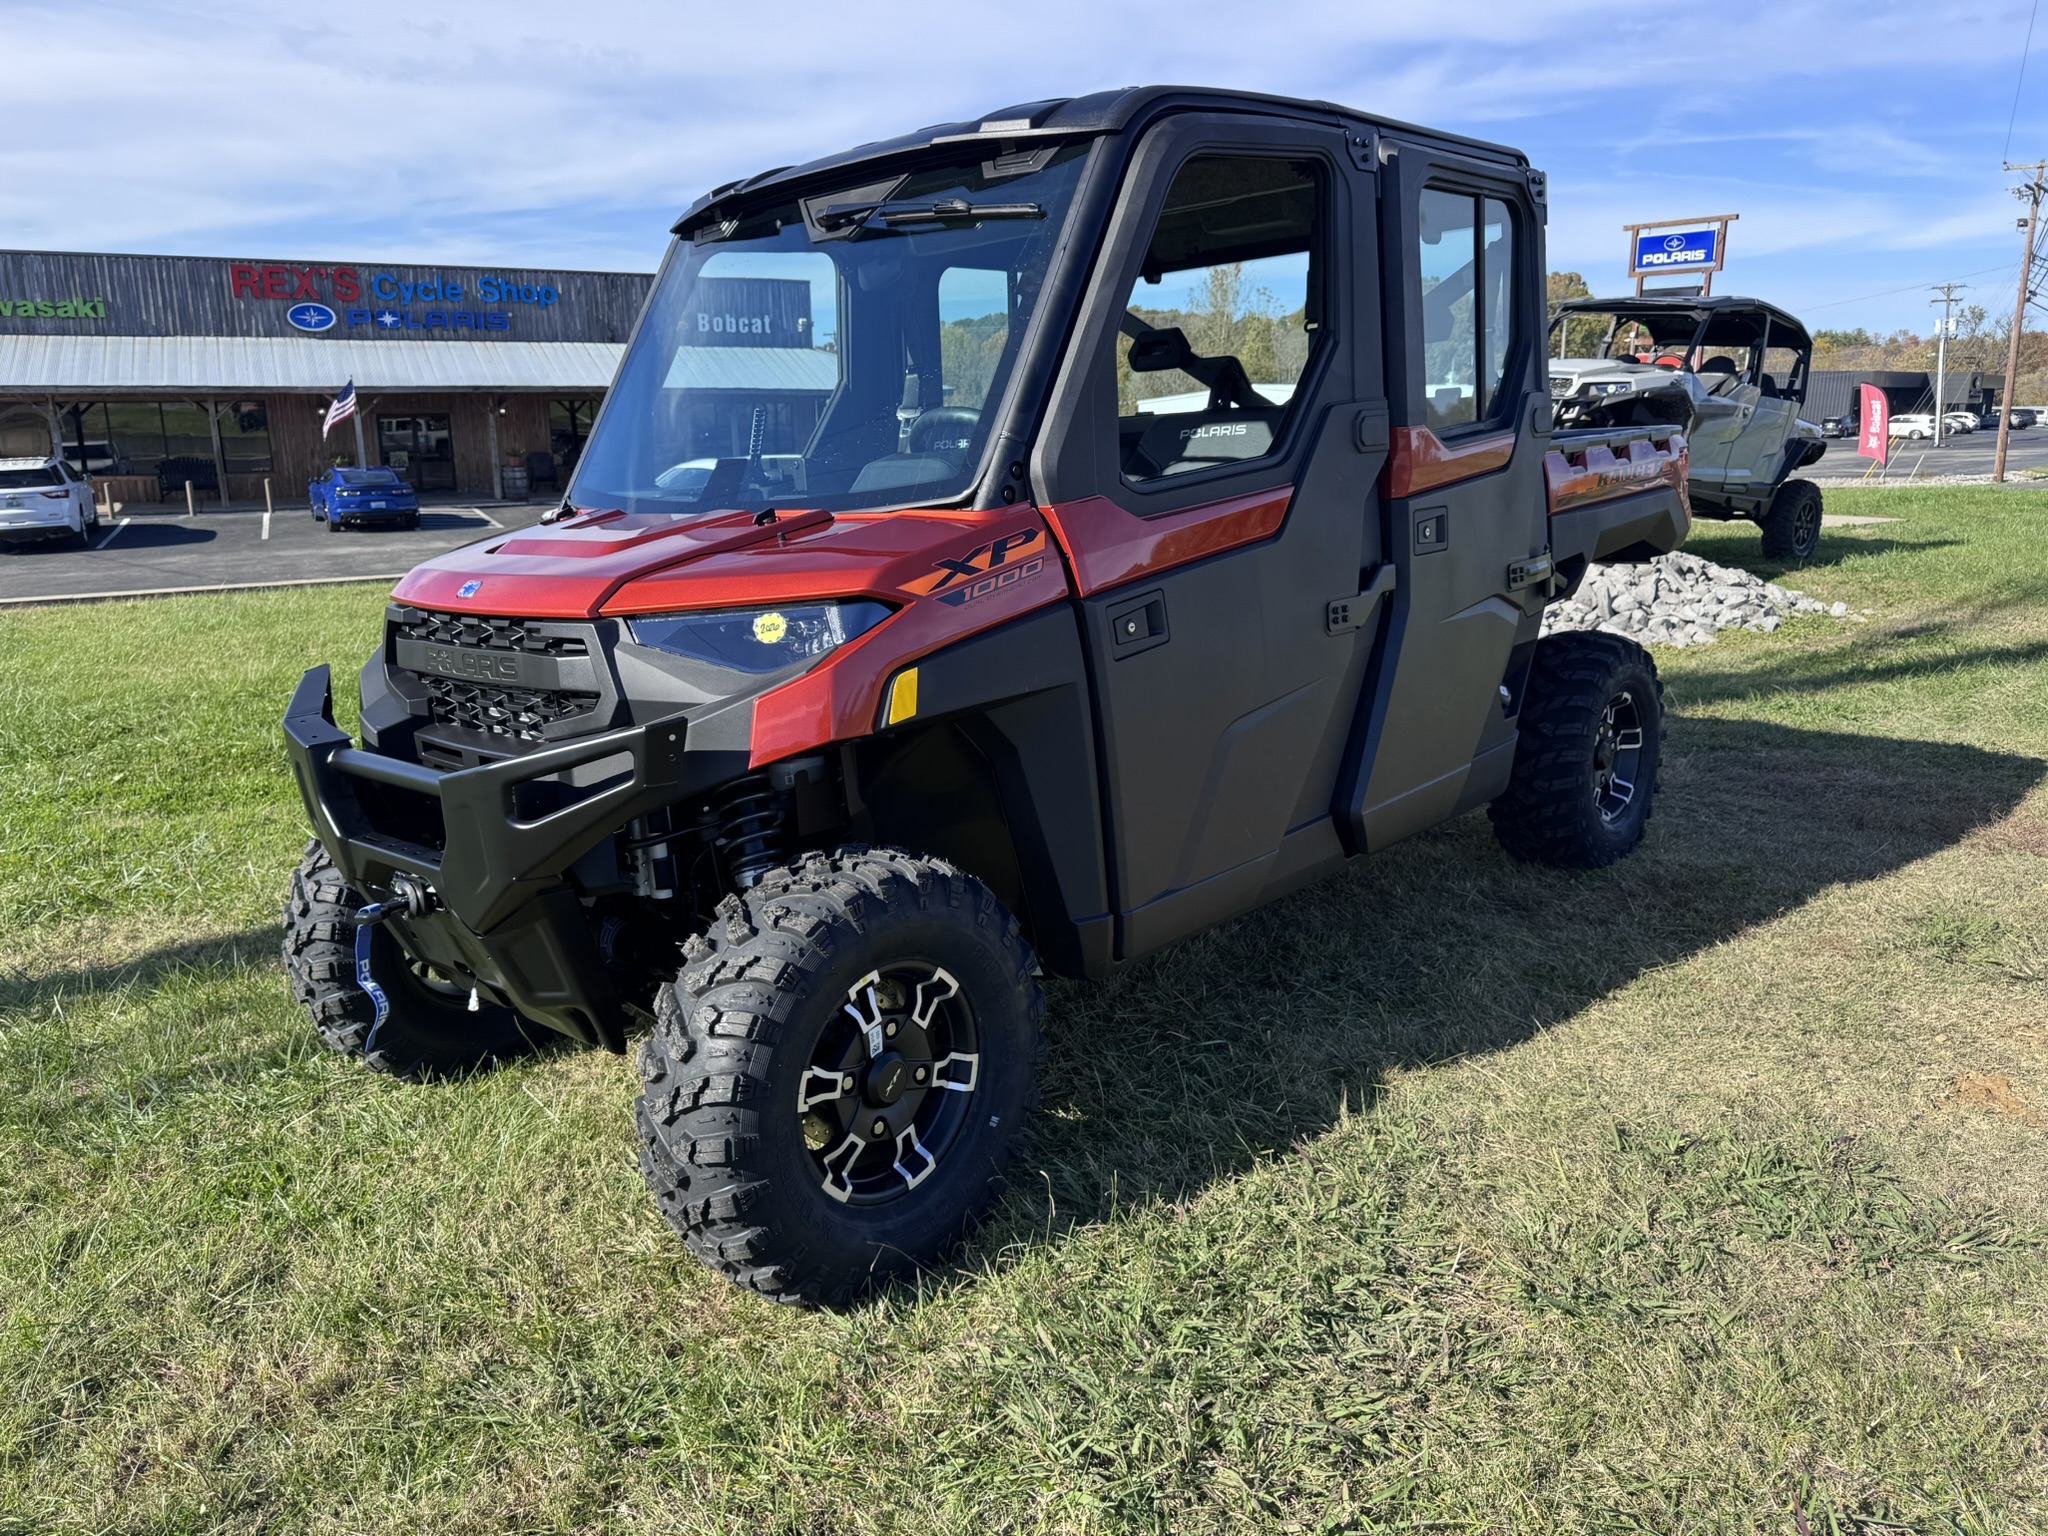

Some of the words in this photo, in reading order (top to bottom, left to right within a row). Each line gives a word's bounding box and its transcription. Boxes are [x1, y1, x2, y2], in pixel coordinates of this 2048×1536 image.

[1642, 249, 1706, 265] POLARIS
[231, 265, 361, 302] REX'S
[372, 273, 464, 306] Cycle
[478, 276, 558, 309] Shop
[346, 309, 510, 331] POLARIS
[697, 313, 771, 334] Bobcat
[1179, 424, 1247, 440] POLARIS
[1870, 400, 1881, 433] Bobcat
[927, 527, 1041, 592] XP
[963, 558, 1043, 601] 1000
[425, 646, 520, 682] POLARIS
